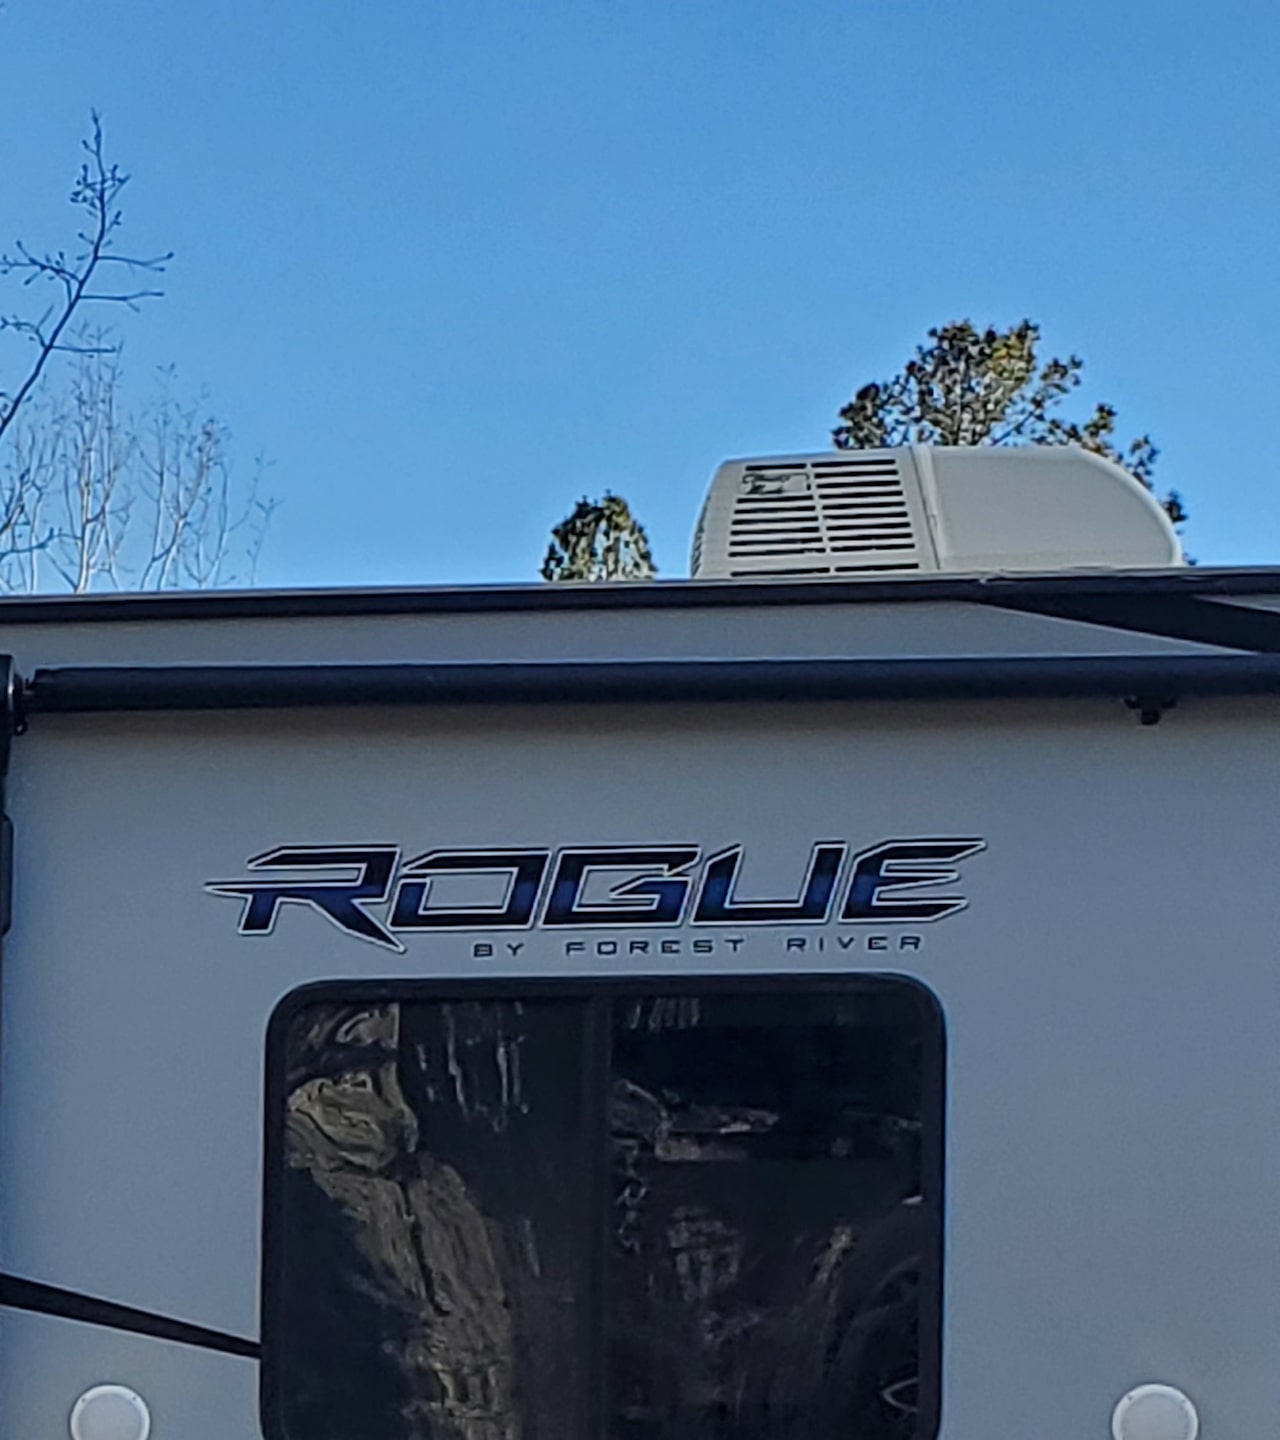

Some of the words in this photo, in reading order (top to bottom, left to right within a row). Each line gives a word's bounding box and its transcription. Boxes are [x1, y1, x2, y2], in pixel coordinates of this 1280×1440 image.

[205, 837, 987, 952] ROGUE
[472, 942, 525, 958] BY
[565, 938, 745, 957] FOREST
[785, 936, 922, 953] RIVER
